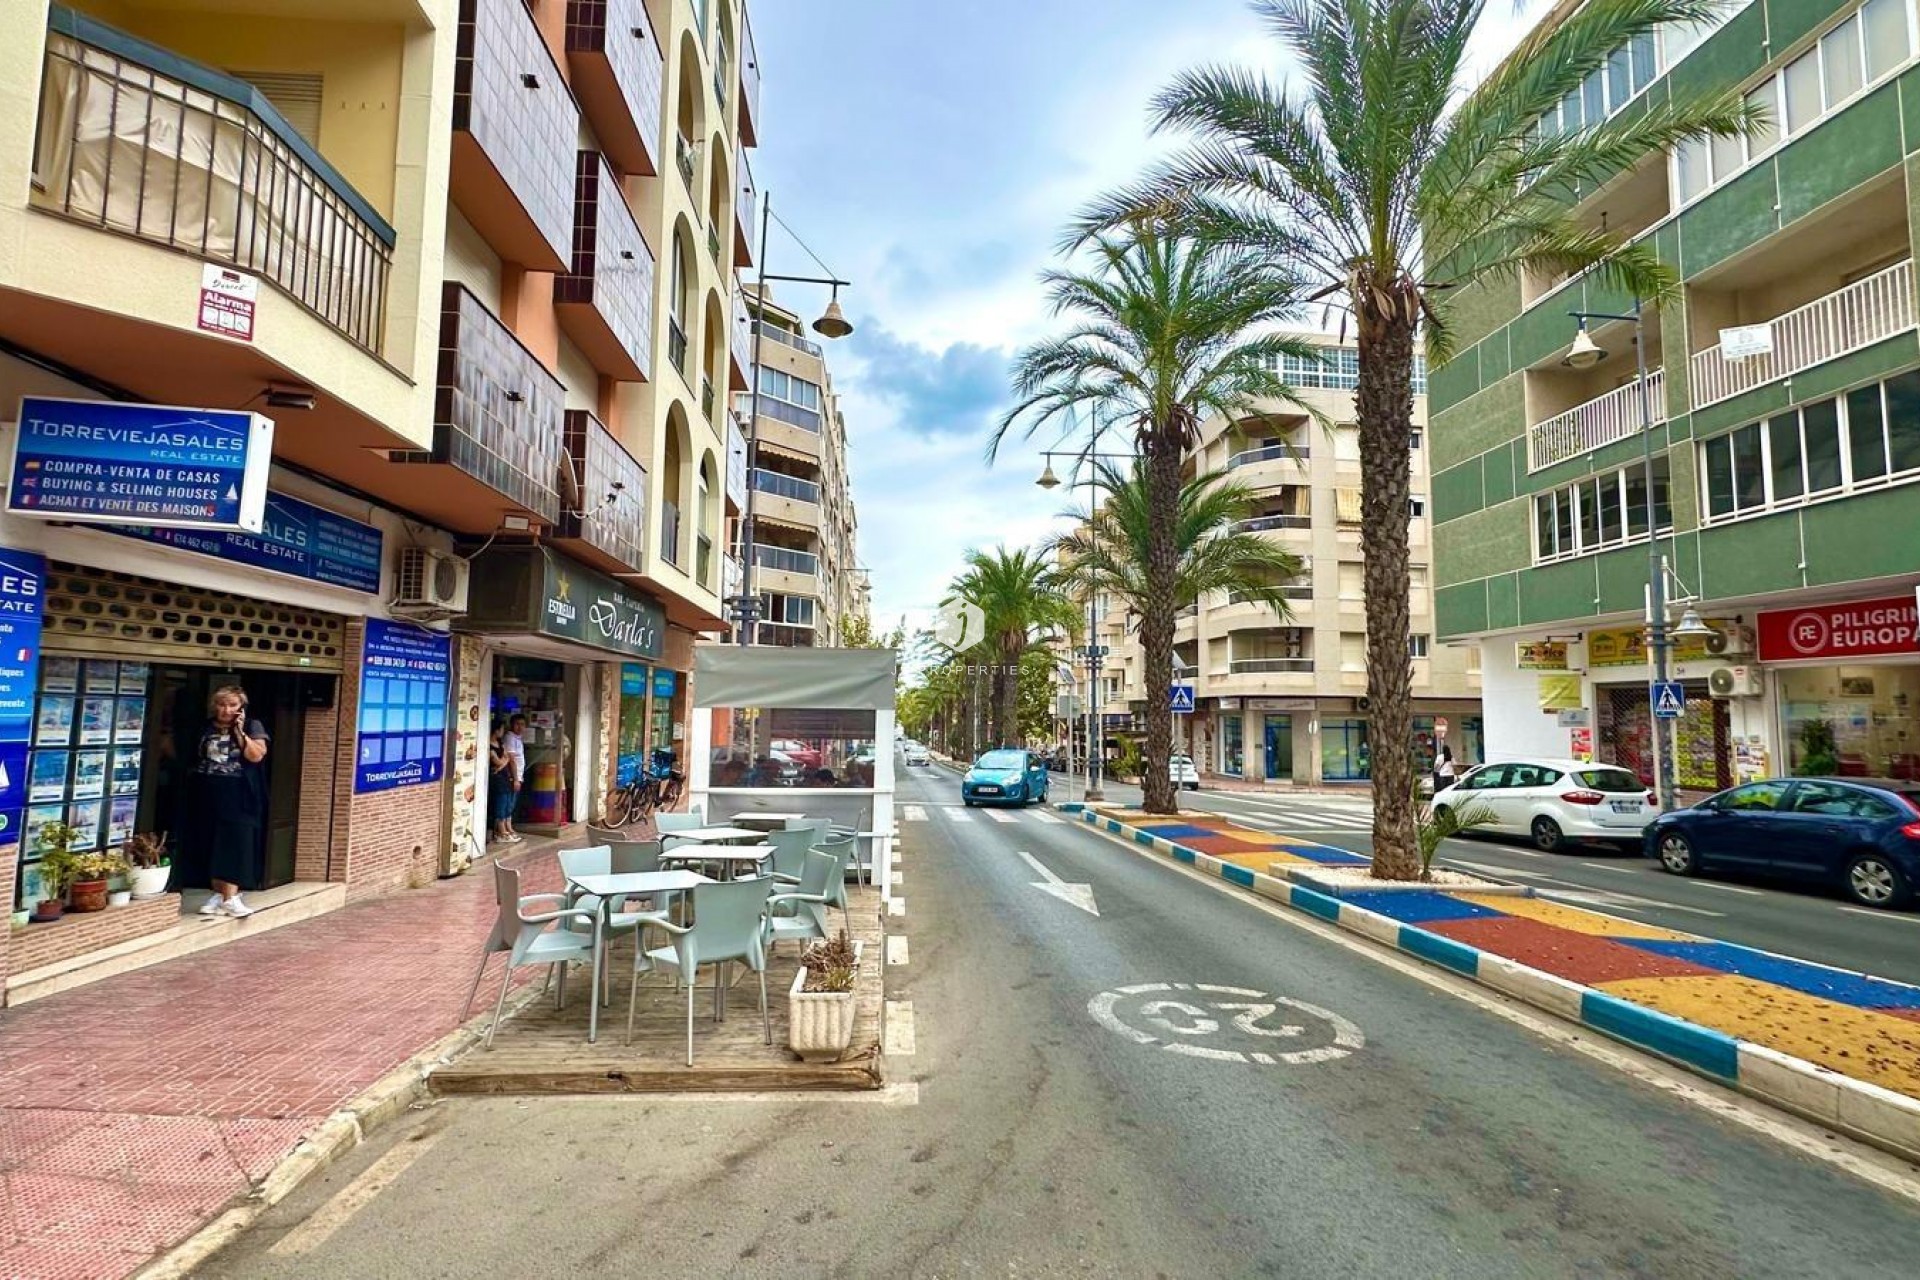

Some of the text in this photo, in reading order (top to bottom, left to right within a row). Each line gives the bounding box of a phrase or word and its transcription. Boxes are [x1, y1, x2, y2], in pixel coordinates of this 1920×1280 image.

[204, 291, 252, 312] Alarma
[28, 419, 243, 451] TORREVIEJASALES
[150, 449, 241, 463] REAL ESTATE
[45, 460, 221, 484] COMPRA-VENTA DE CASAS
[42, 477, 218, 500] BUYING & SELLING HOUSES
[39, 494, 215, 517] ACHAT ET VENTE DES MAISONS
[226, 533, 258, 549] REAL
[263, 542, 305, 562] ESTATE
[589, 595, 654, 649] Darla's
